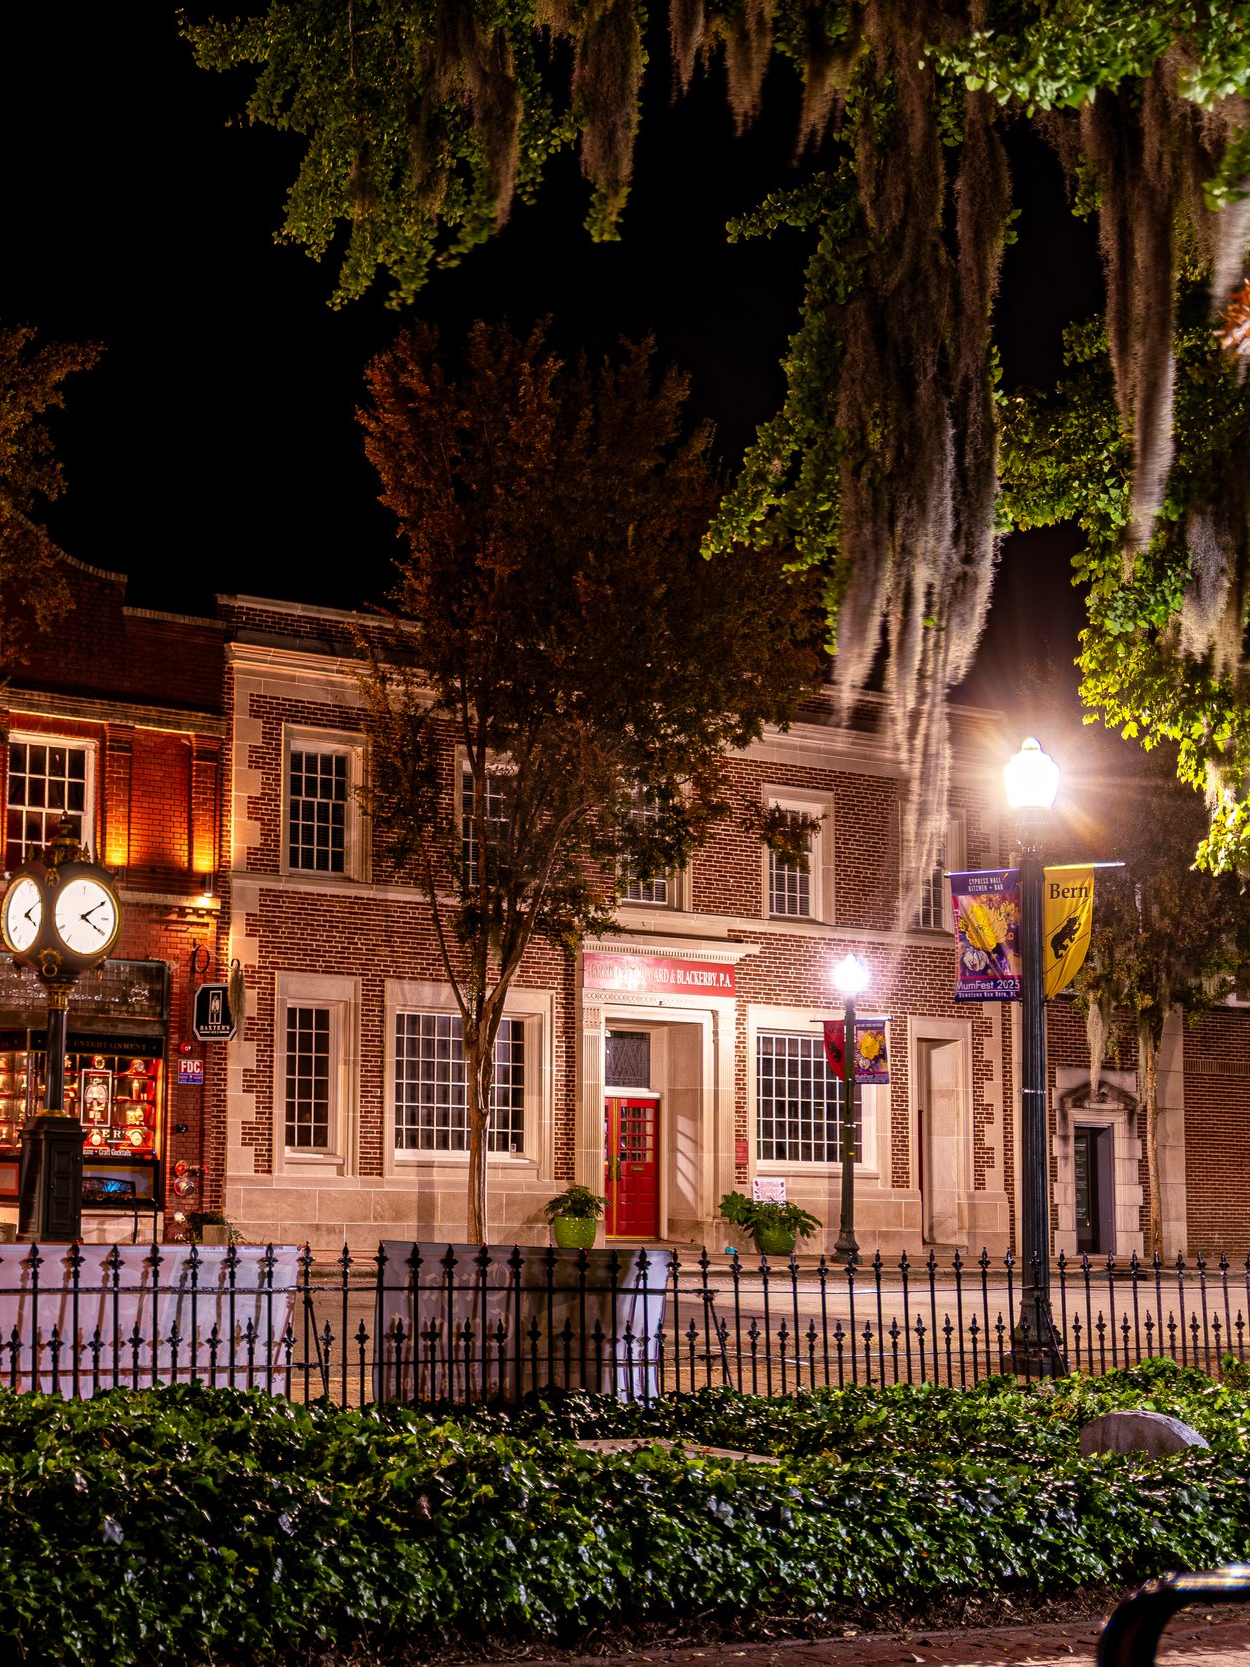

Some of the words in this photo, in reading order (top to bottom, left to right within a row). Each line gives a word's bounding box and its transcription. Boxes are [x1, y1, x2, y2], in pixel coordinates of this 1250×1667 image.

[1049, 883, 1089, 900] Bern
[670, 970, 676, 984] &
[719, 973, 732, 988] P.A.
[996, 979, 1020, 990] 2025
[73, 1040, 147, 1051] ENTERTAINMENT
[180, 1061, 201, 1073] FDC
